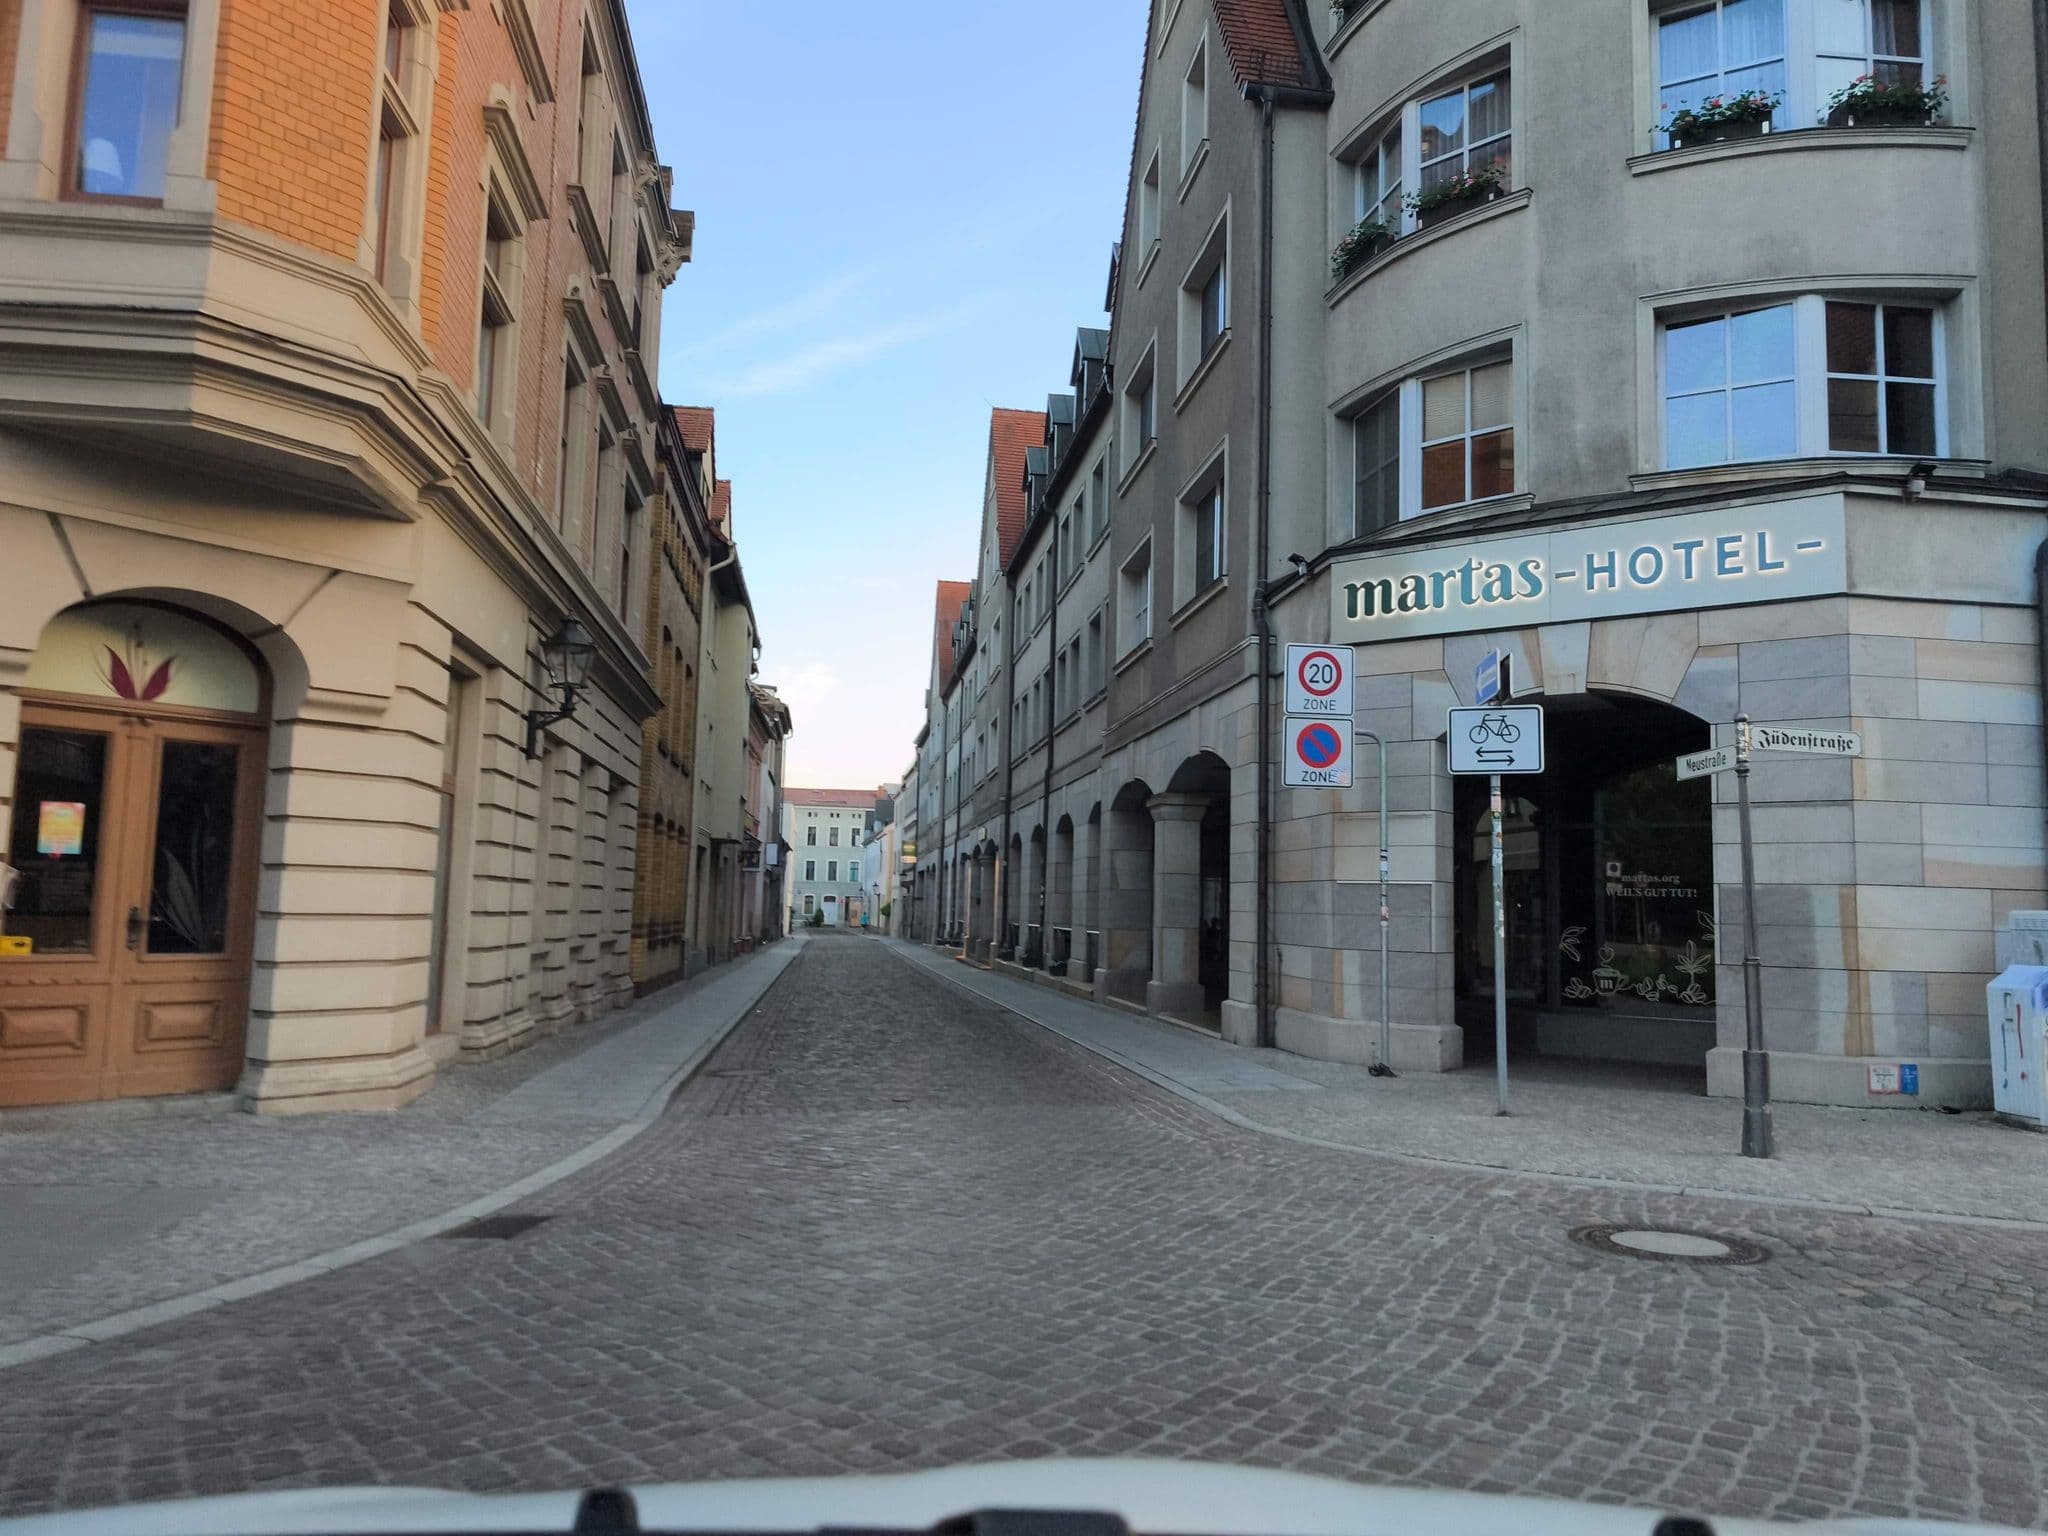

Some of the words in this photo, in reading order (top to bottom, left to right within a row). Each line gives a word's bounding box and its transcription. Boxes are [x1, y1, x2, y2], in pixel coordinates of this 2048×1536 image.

[1343, 557, 1544, 619] martas
[1308, 664, 1333, 684] 20
[1303, 699, 1337, 711] ZONE
[1758, 729, 1853, 752] Jüdenstraße
[1686, 752, 1727, 772] Neustraße
[1301, 770, 1337, 783] ZONE
[1621, 874, 1681, 885] martas.org
[1643, 888, 1668, 897] GUT
[1670, 888, 1697, 898] TUT!
